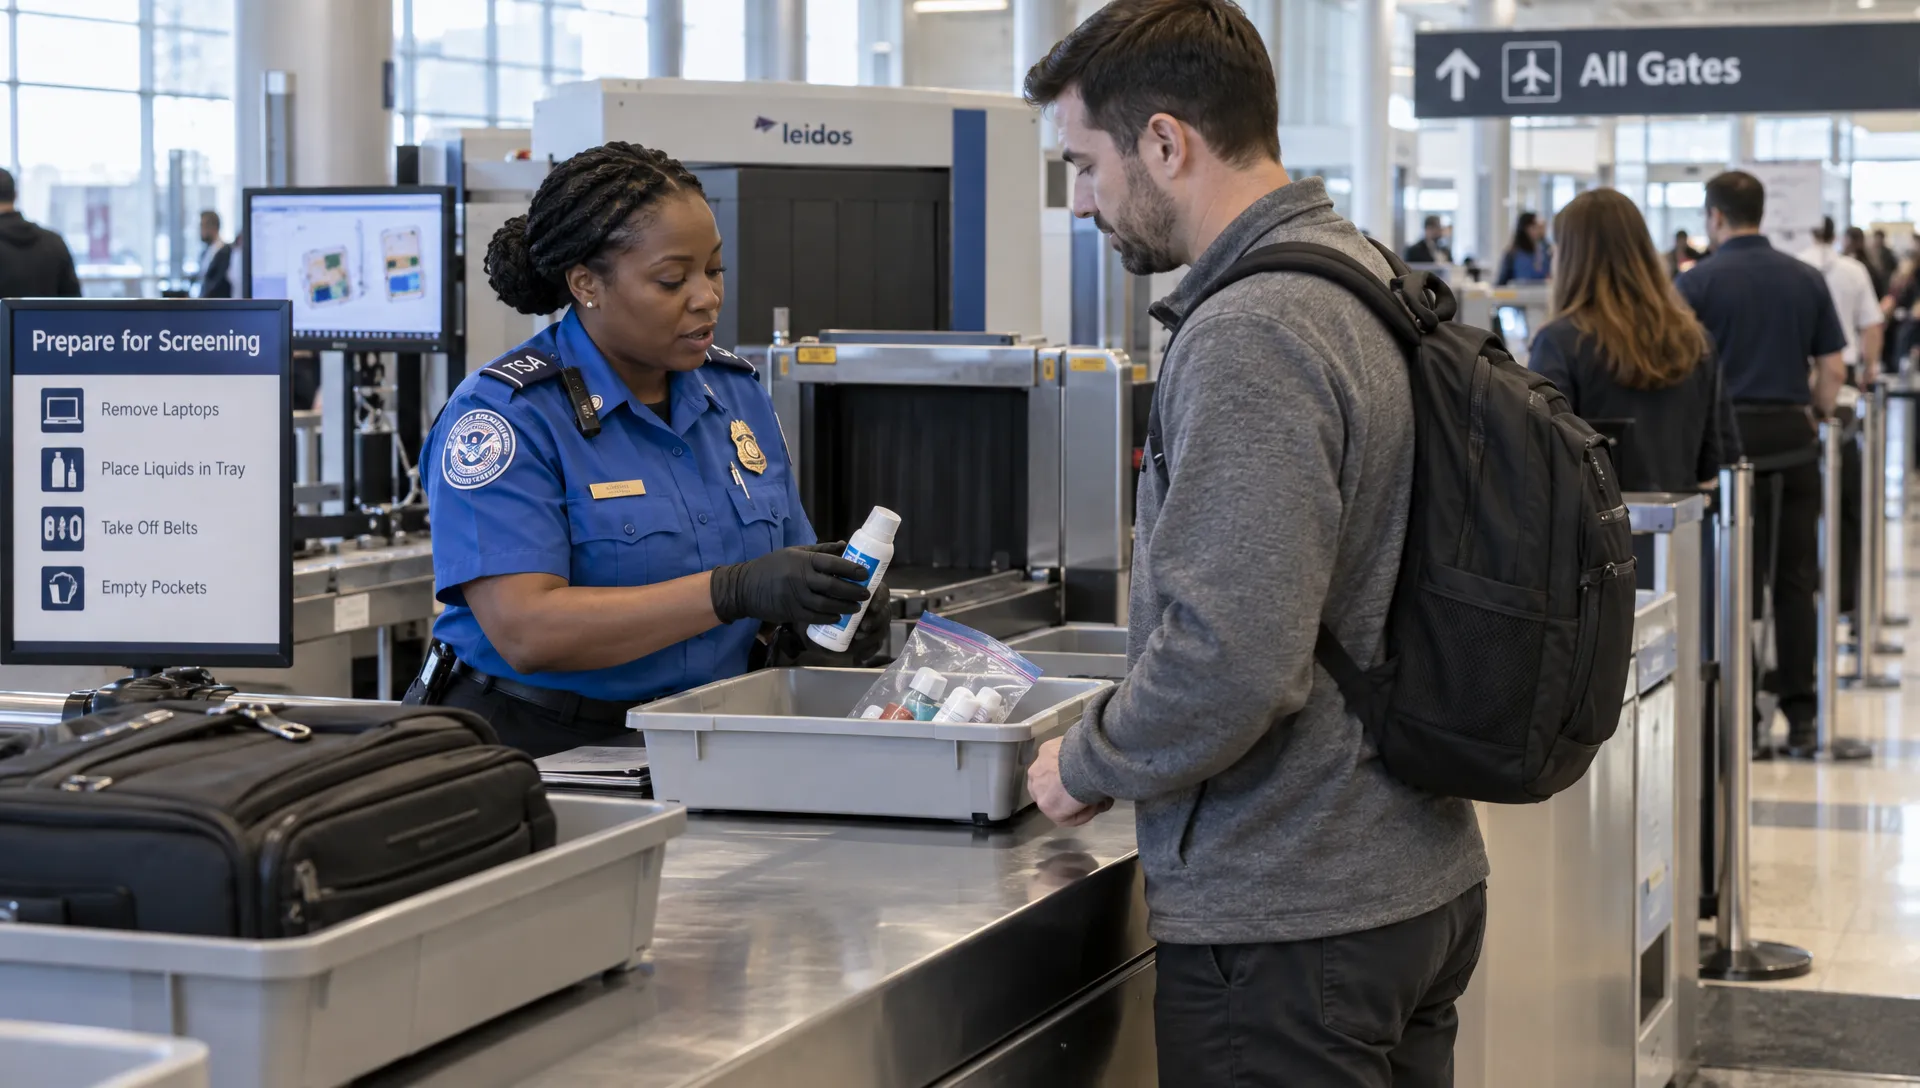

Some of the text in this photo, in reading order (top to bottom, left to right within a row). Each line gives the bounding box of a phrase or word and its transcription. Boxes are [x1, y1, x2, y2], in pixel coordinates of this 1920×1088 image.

[1579, 50, 1742, 88] All Gates
[783, 122, 853, 146] leidos
[32, 329, 261, 357] Prepare for Screening
[502, 354, 547, 376] TSA
[101, 402, 220, 420] Remove Laptops
[101, 461, 246, 480] Place Liquids in Tray
[101, 520, 198, 535] Take Off Belts
[102, 580, 207, 598] Empty Pockets
